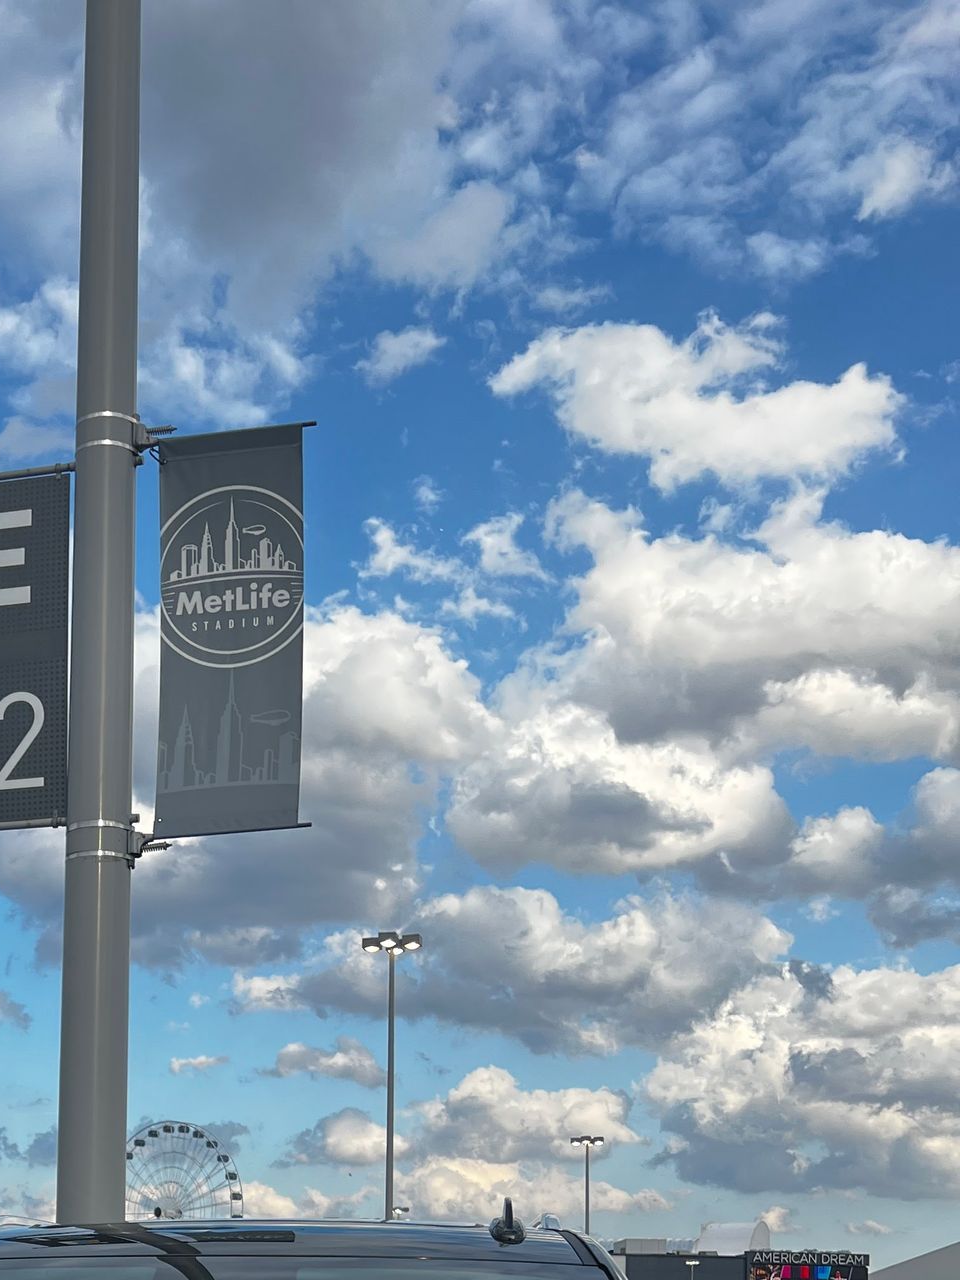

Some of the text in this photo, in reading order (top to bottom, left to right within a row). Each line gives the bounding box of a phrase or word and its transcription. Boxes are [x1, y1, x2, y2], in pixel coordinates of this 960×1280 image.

[175, 582, 291, 616] MetLife
[191, 615, 275, 632] STADIUM
[753, 1252, 865, 1265] AMERICAN DREAM
